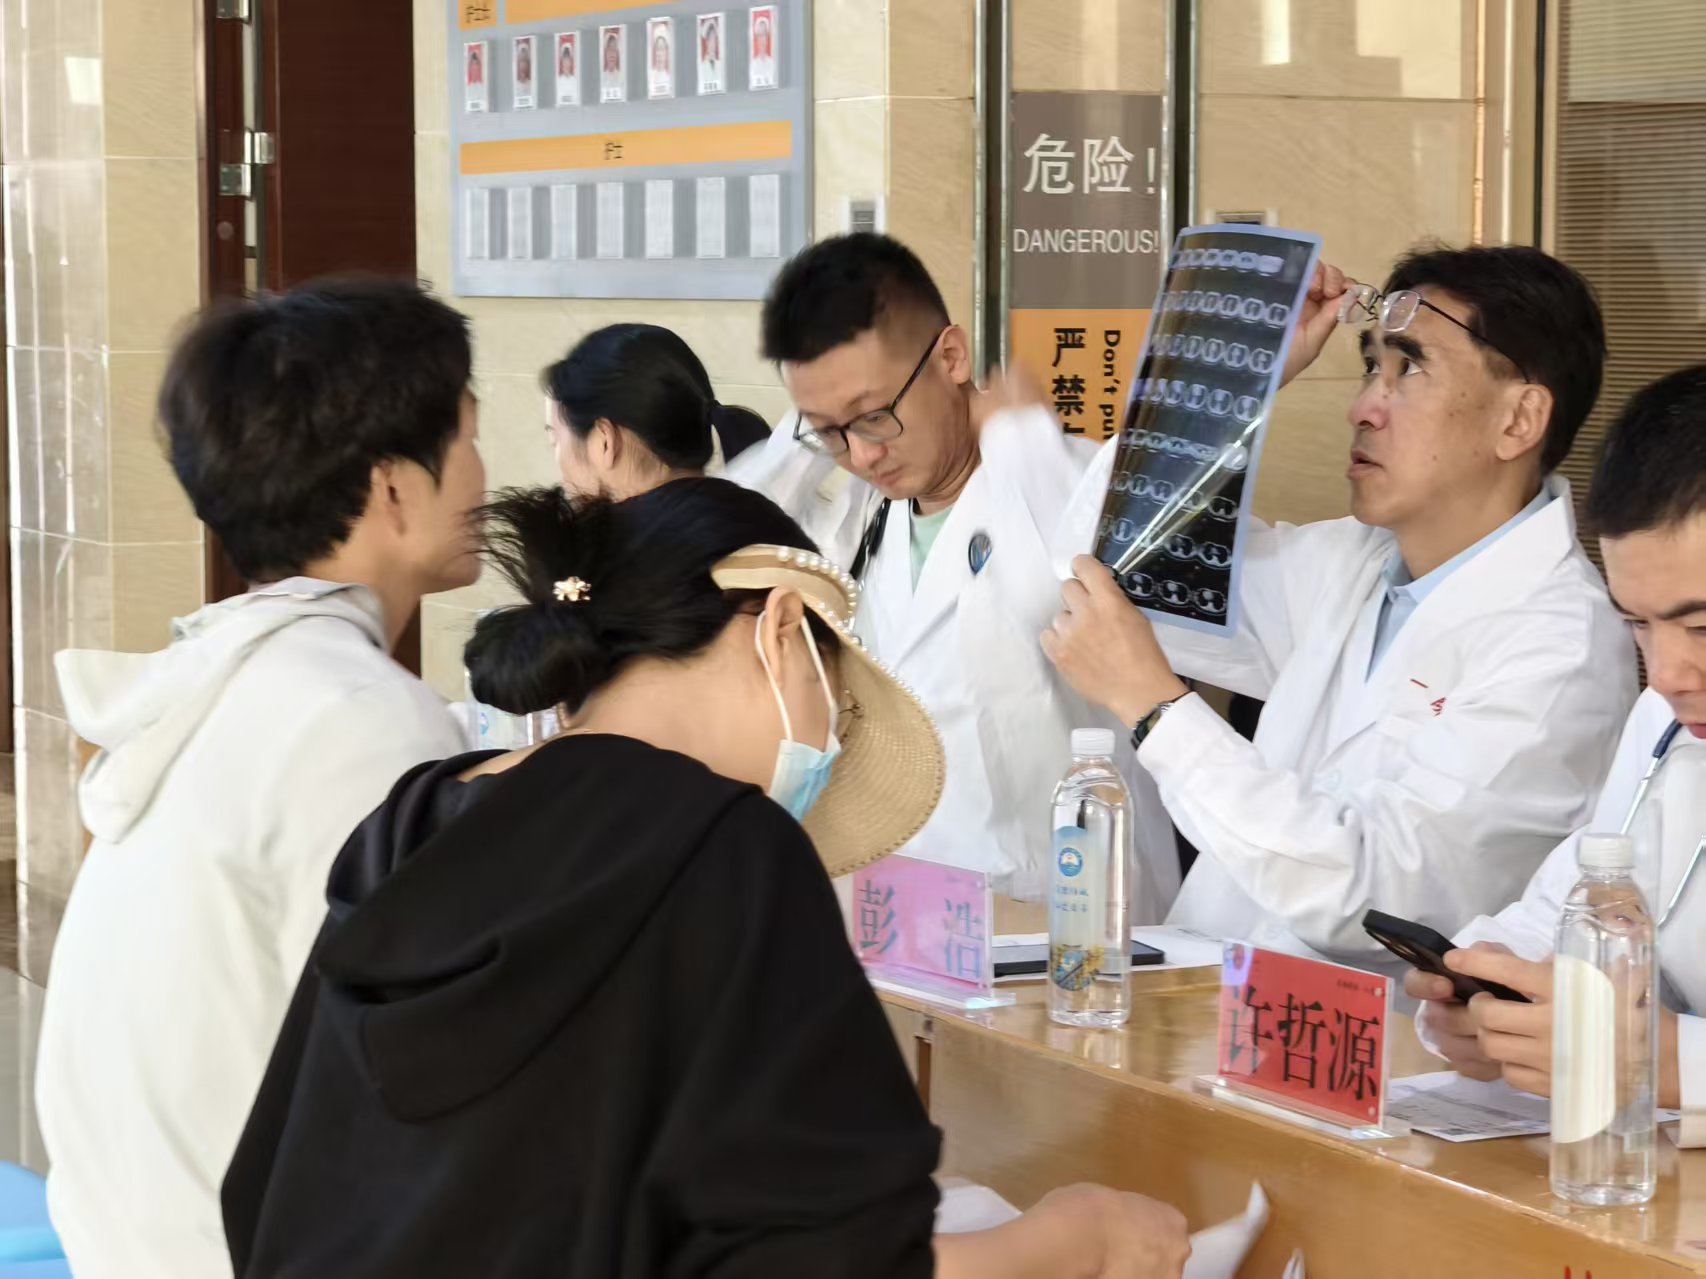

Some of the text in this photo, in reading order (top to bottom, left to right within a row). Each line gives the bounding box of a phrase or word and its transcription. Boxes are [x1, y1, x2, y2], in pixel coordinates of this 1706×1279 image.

[1022, 133, 1156, 195] 危险!
[1013, 228, 1159, 254] DANGEROUS!
[1103, 330, 1121, 394] Don't
[1222, 984, 1381, 1101] 许哲源
